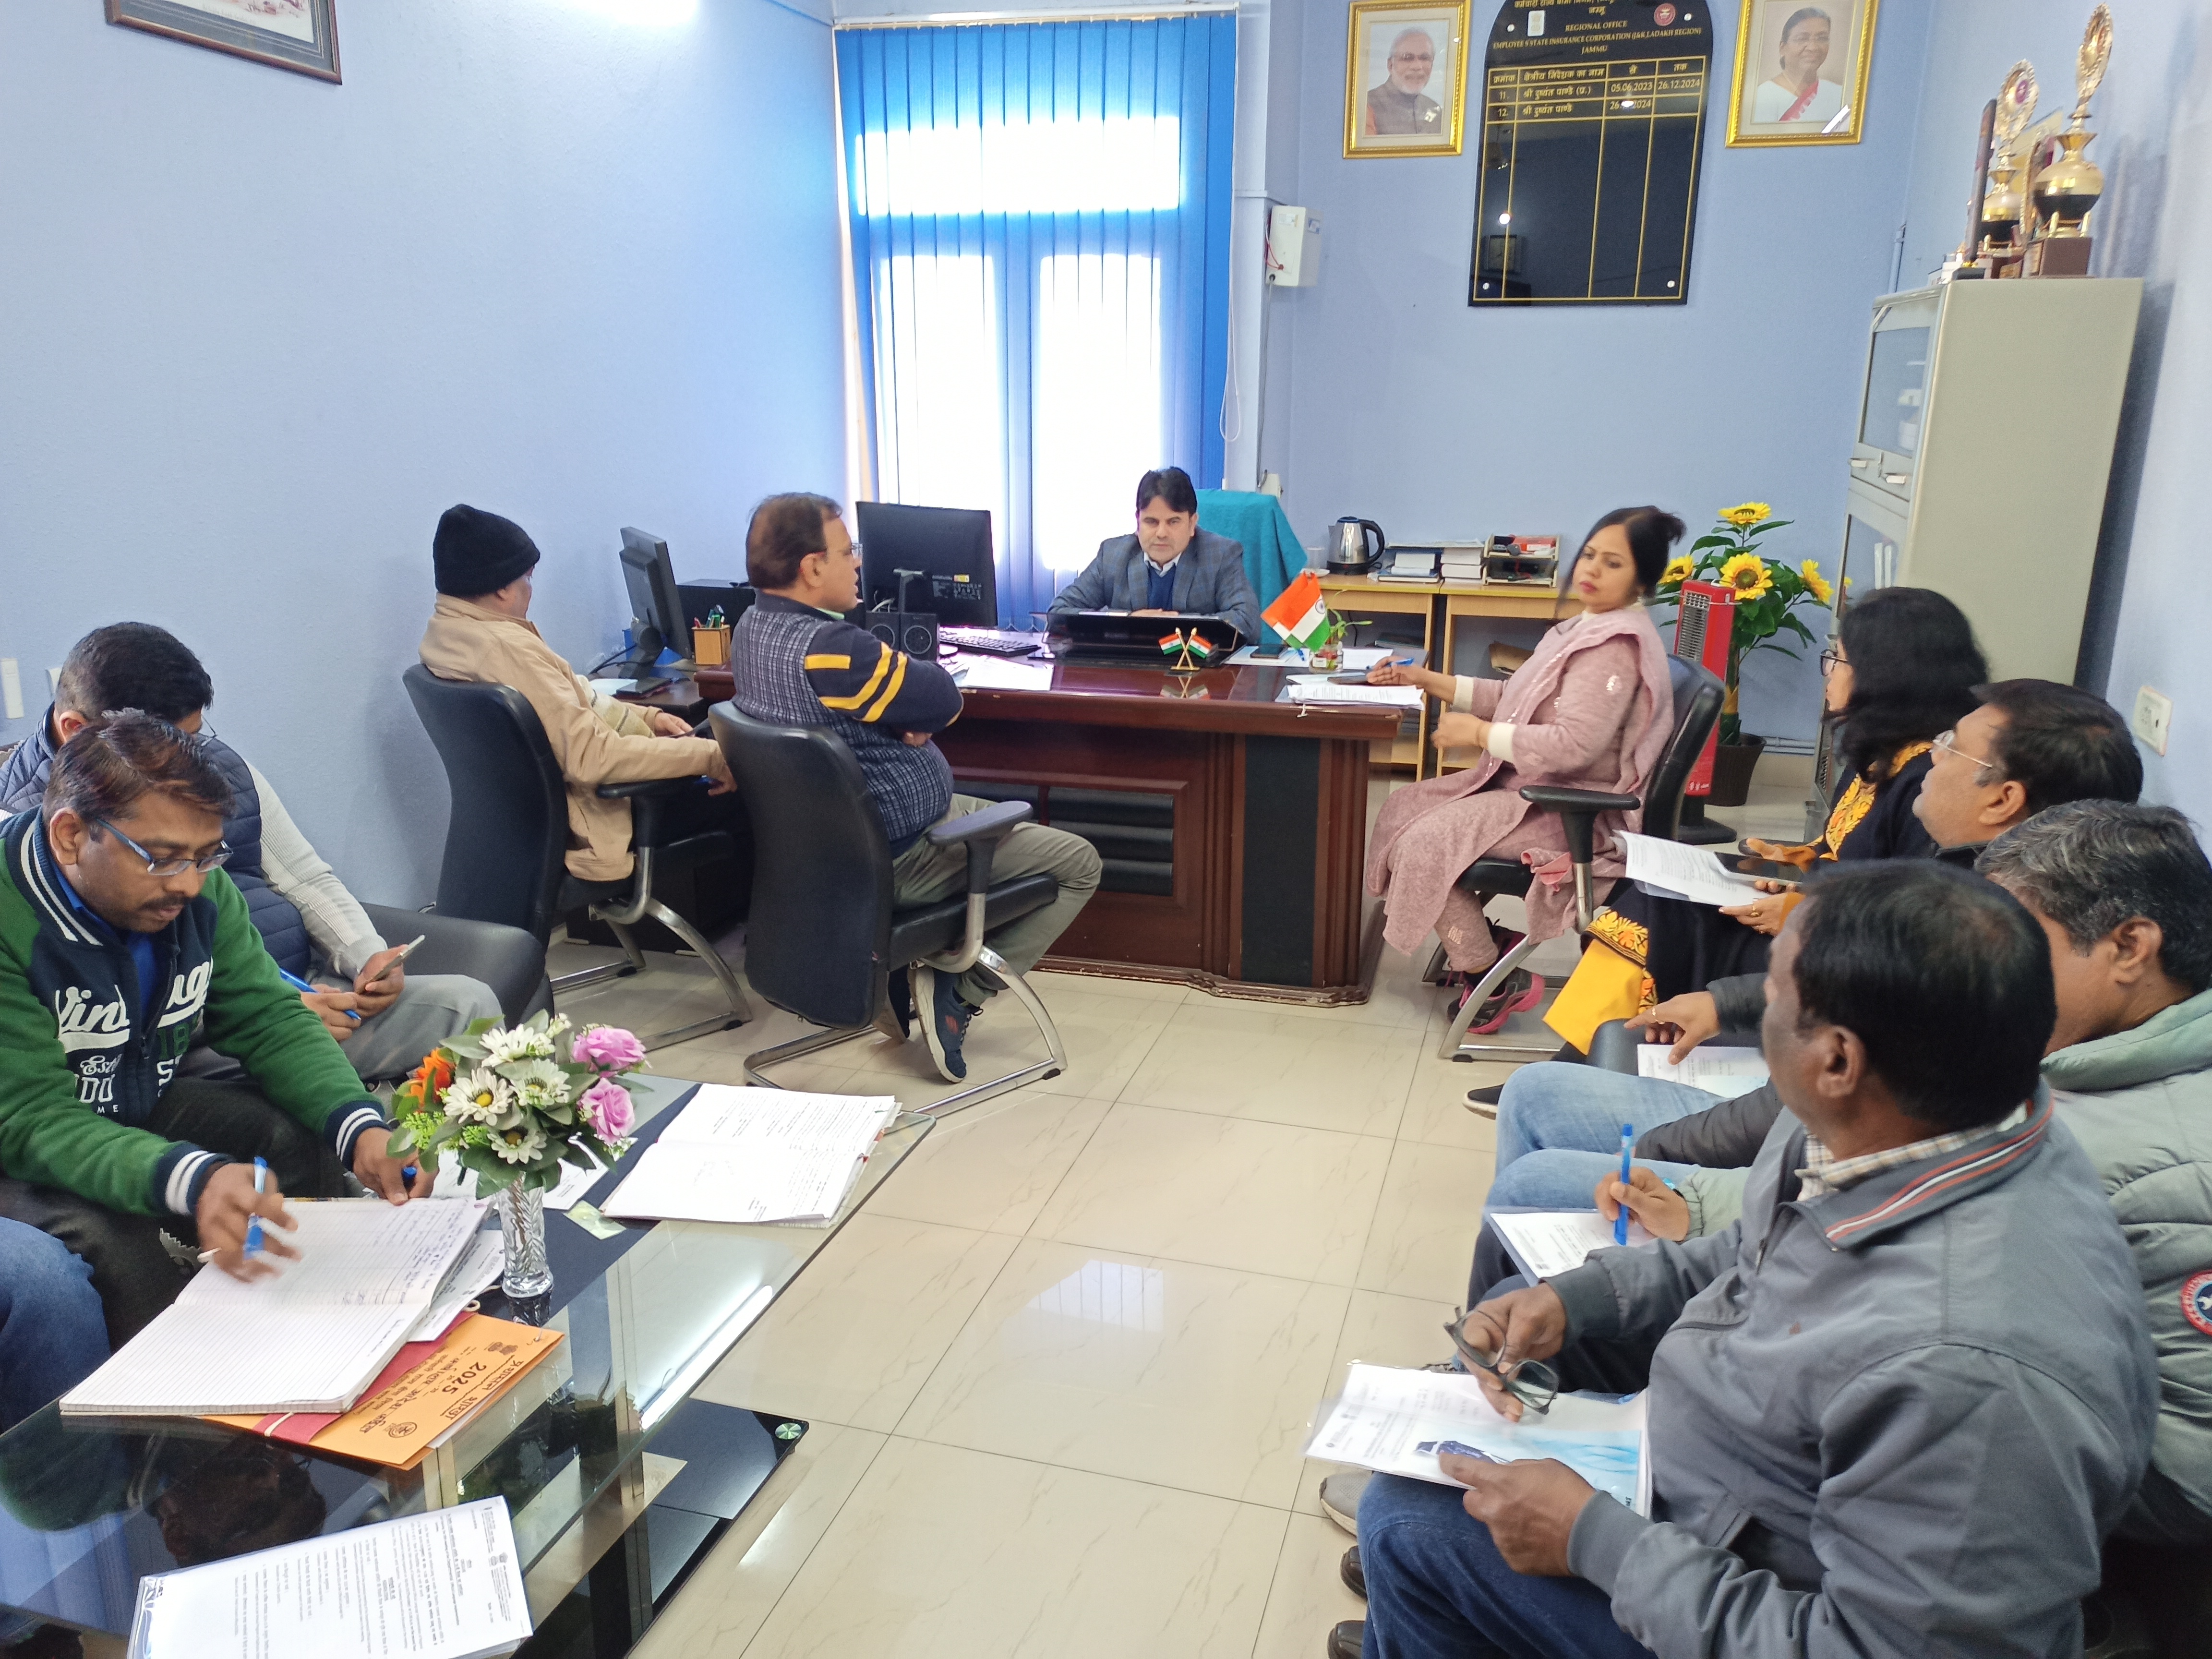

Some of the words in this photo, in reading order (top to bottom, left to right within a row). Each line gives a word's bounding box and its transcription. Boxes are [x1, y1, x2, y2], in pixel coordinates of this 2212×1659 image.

[1564, 23, 1601, 32] REGIONAL
[1602, 20, 1628, 28] OFFICE
[1529, 38, 1549, 47] STATE
[1549, 36, 1584, 45] INSURANCE
[1585, 32, 1632, 42] CORPORATION
[1674, 27, 1702, 36] REGION)
[1581, 45, 1608, 55] JAMMU
[1576, 69, 1587, 78] का
[1588, 68, 1605, 77] नाम
[1673, 62, 1688, 72] तक
[1523, 87, 1534, 98] श्री
[1611, 81, 1653, 93] 05.06.2023
[1657, 79, 1701, 90] 26.12.2024
[1522, 105, 1533, 116] श्री
[442, 1361, 487, 1395] 2025
